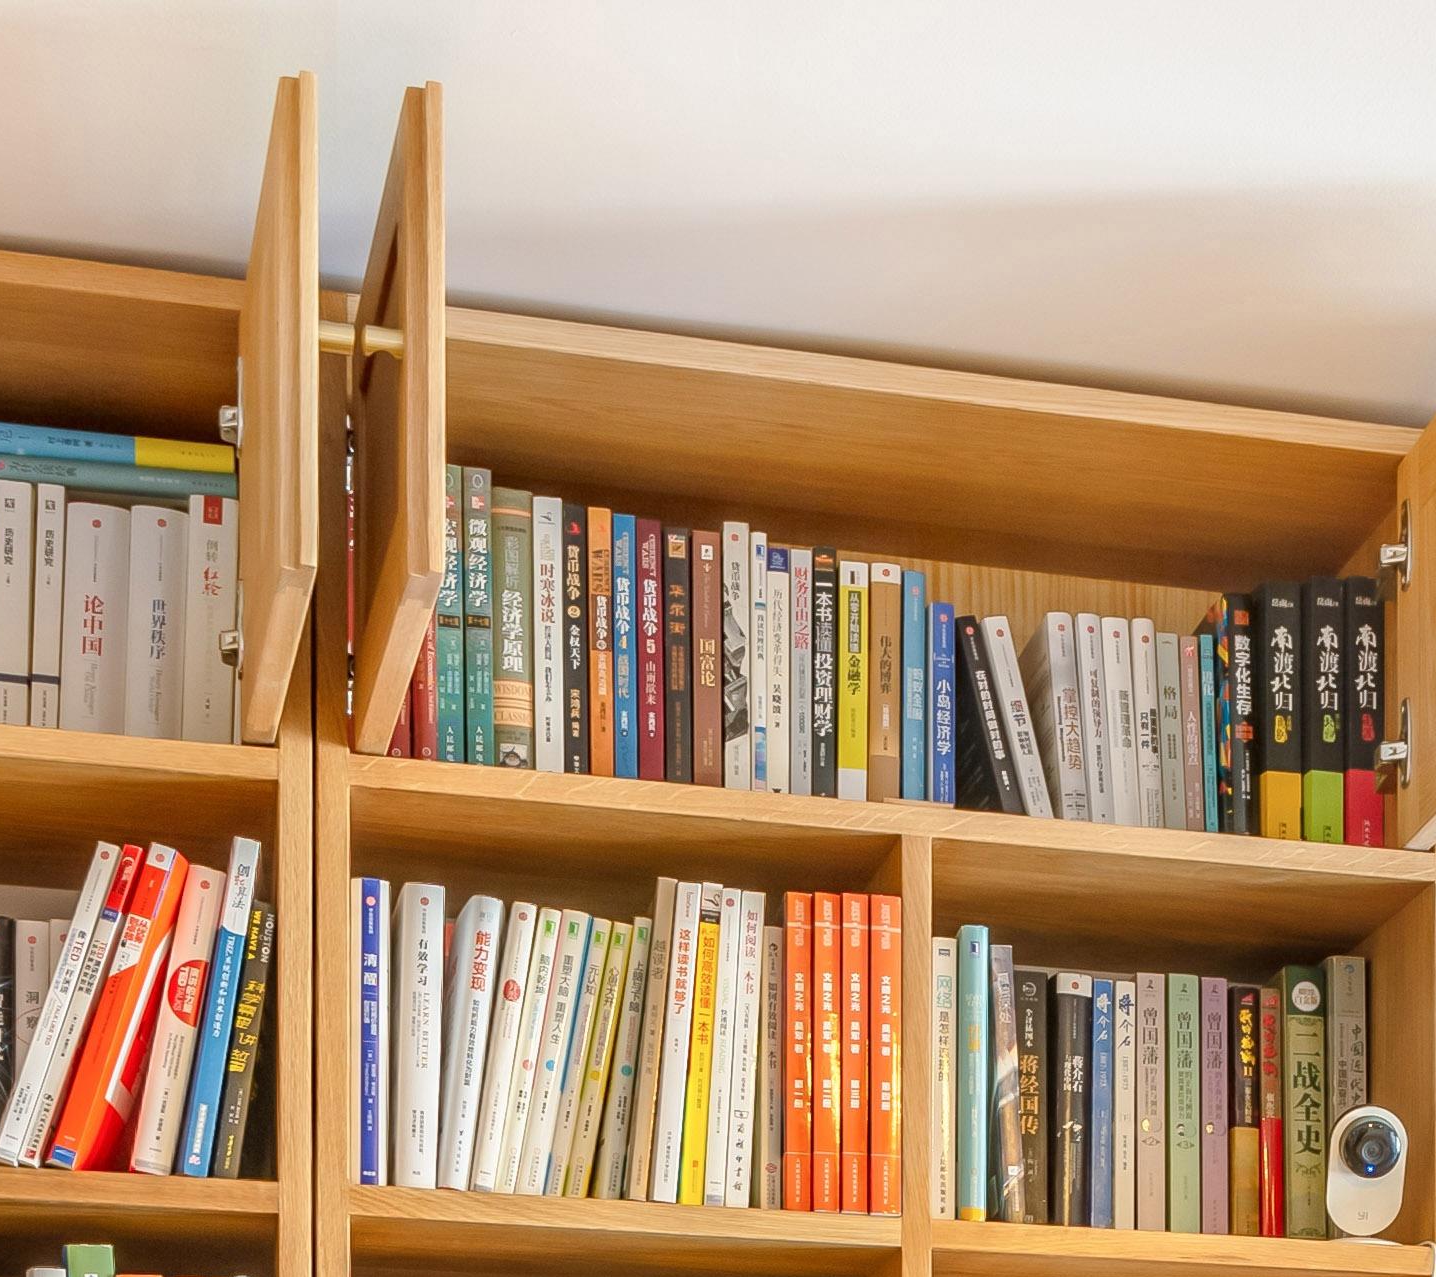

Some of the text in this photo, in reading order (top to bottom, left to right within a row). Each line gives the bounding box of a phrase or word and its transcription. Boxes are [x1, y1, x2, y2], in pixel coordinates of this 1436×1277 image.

[468, 519, 488, 607] 微观经济学
[539, 563, 556, 624] 时寒冰说
[81, 594, 104, 657] 论中国
[149, 598, 167, 661] 世界秩序
[616, 578, 632, 634] 货币战争
[643, 578, 658, 635] 货币战争
[646, 640, 655, 653] 5
[1235, 635, 1251, 715] 数字化生存
[1270, 625, 1295, 712] 南渡北归
[1315, 624, 1339, 711] 南渡北归
[1355, 623, 1378, 710] 南渡北归
[936, 679, 951, 755] 小岛经济学
[416, 939, 429, 987] 有效学习
[471, 929, 492, 992] 能力变现
[672, 927, 690, 1014] 这样读书就够了
[743, 909, 758, 996] 如何阅读一本书
[697, 936, 714, 1045] 如何高效读懂一本书
[1143, 1007, 1158, 1064] 曾国藩
[1177, 1010, 1192, 1069] 曾国藩
[1207, 1011, 1222, 1069] 曾国藩
[1020, 1054, 1040, 1134] 蒋经国传
[1293, 1025, 1322, 1156] 二战全史
